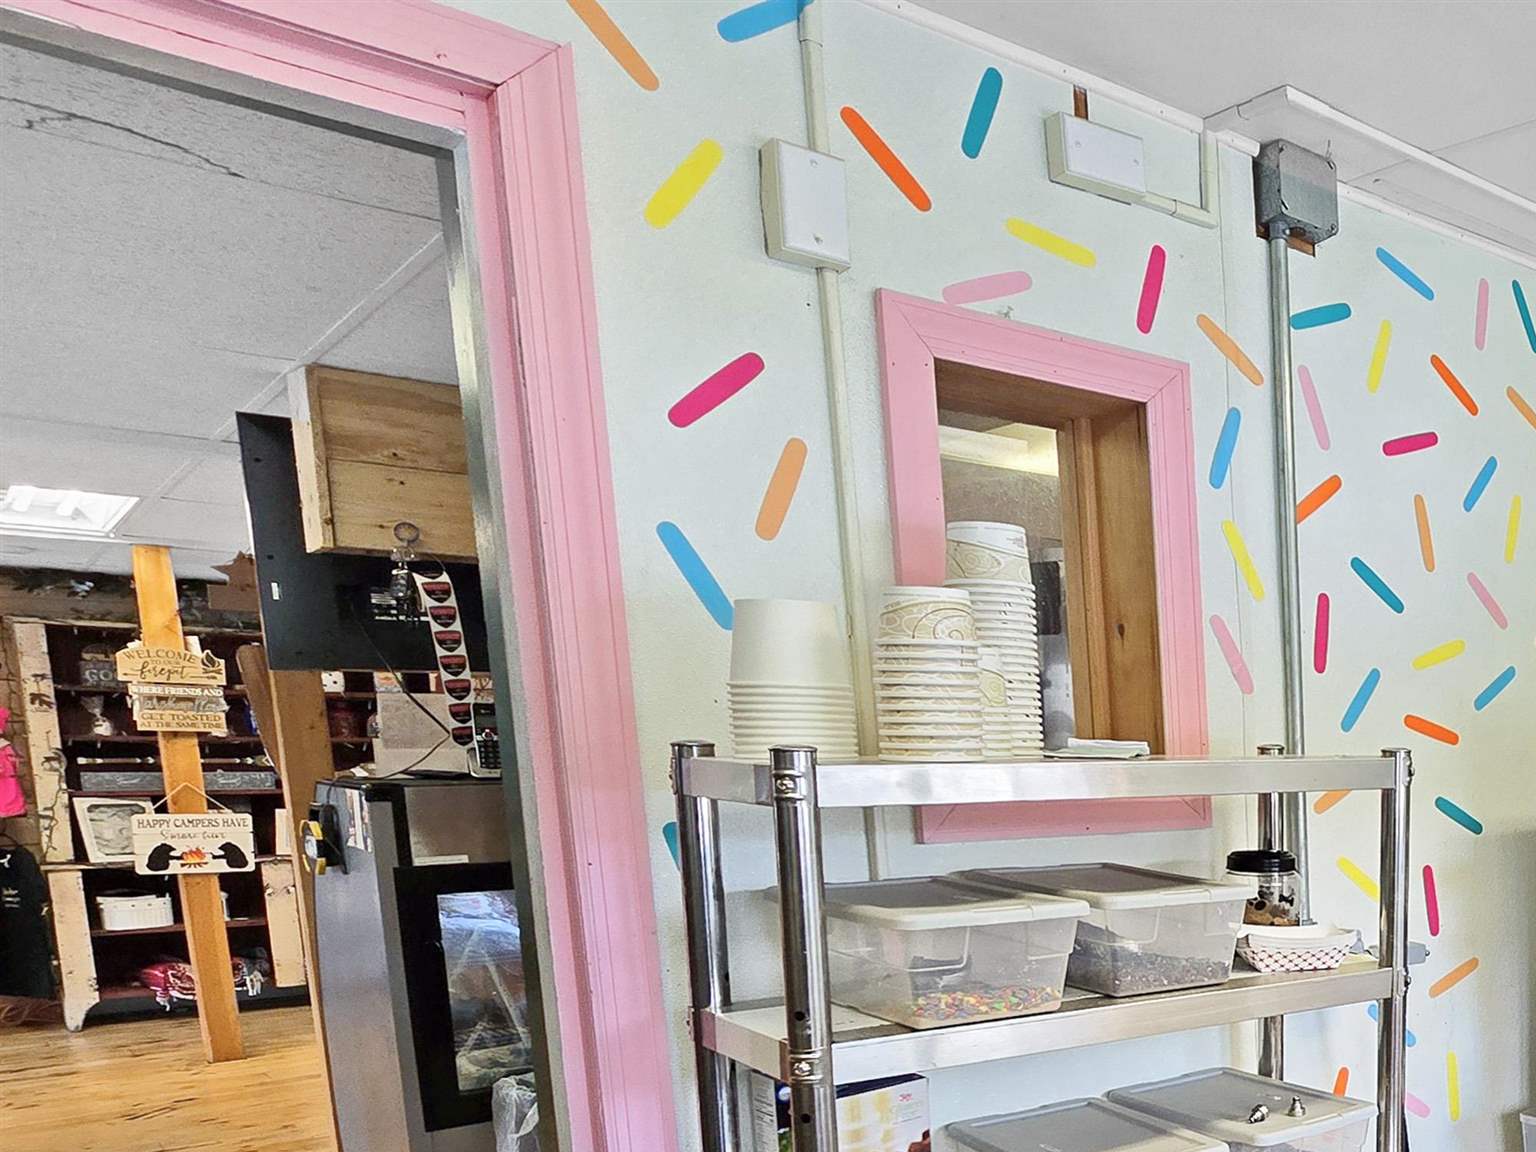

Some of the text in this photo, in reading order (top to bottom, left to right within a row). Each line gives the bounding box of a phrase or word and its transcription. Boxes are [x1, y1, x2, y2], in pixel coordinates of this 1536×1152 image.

[123, 649, 199, 664] WELCOME
[165, 686, 202, 696] FRIENDS
[203, 688, 224, 697] AND
[140, 712, 222, 722] GET TOASTED
[140, 721, 225, 731] AT THE SAME TIME
[137, 817, 248, 829] HAPPY CAMPERS HAVE
